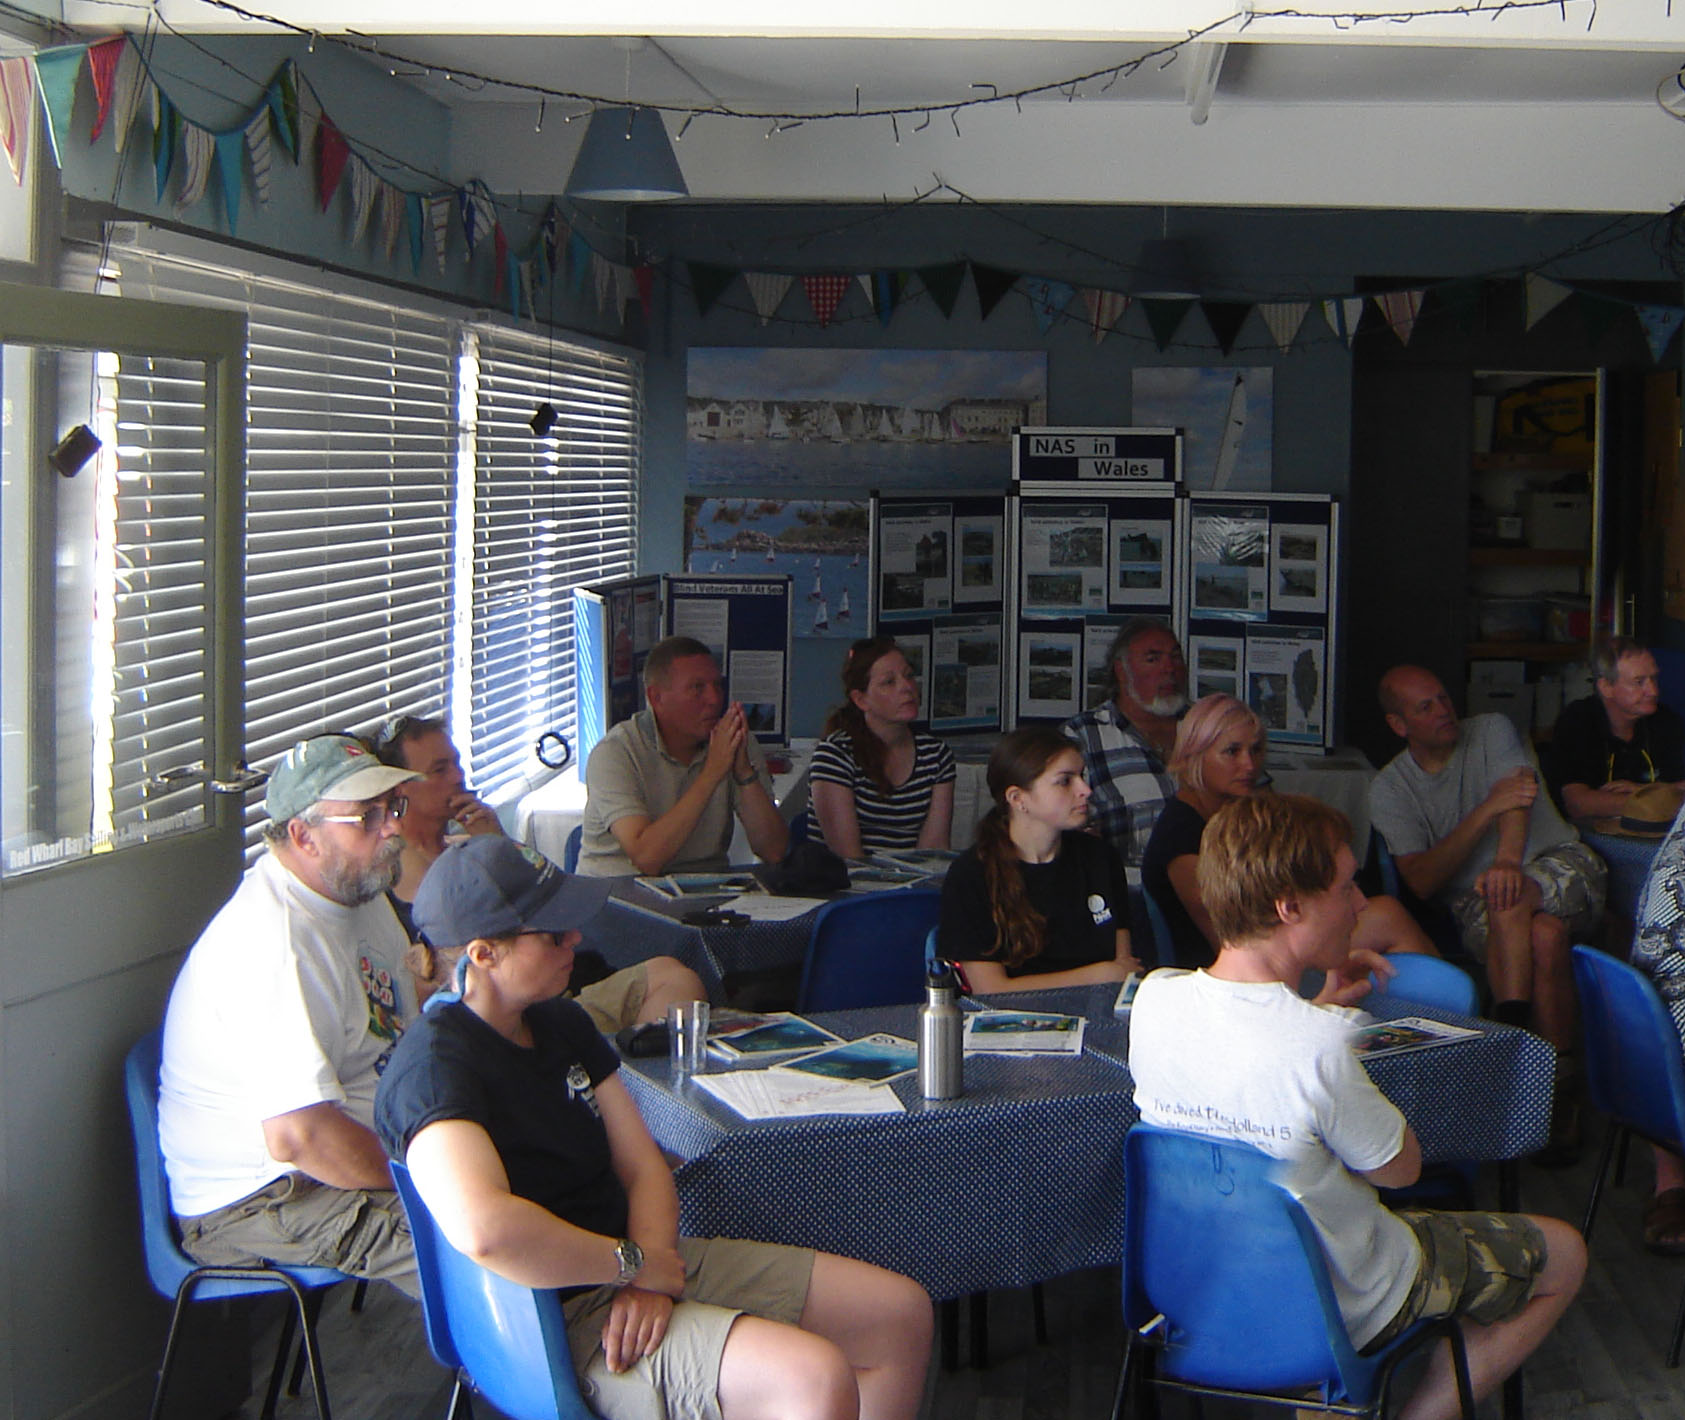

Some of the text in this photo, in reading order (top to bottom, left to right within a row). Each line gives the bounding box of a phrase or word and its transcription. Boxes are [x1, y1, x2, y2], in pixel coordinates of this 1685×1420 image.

[1035, 438, 1110, 454] NAS in
[1094, 460, 1148, 476] Wales
[9, 847, 31, 869] Red
[32, 838, 64, 864] Wharf
[65, 836, 84, 856] Bay
[1280, 1126, 1292, 1140] 5
